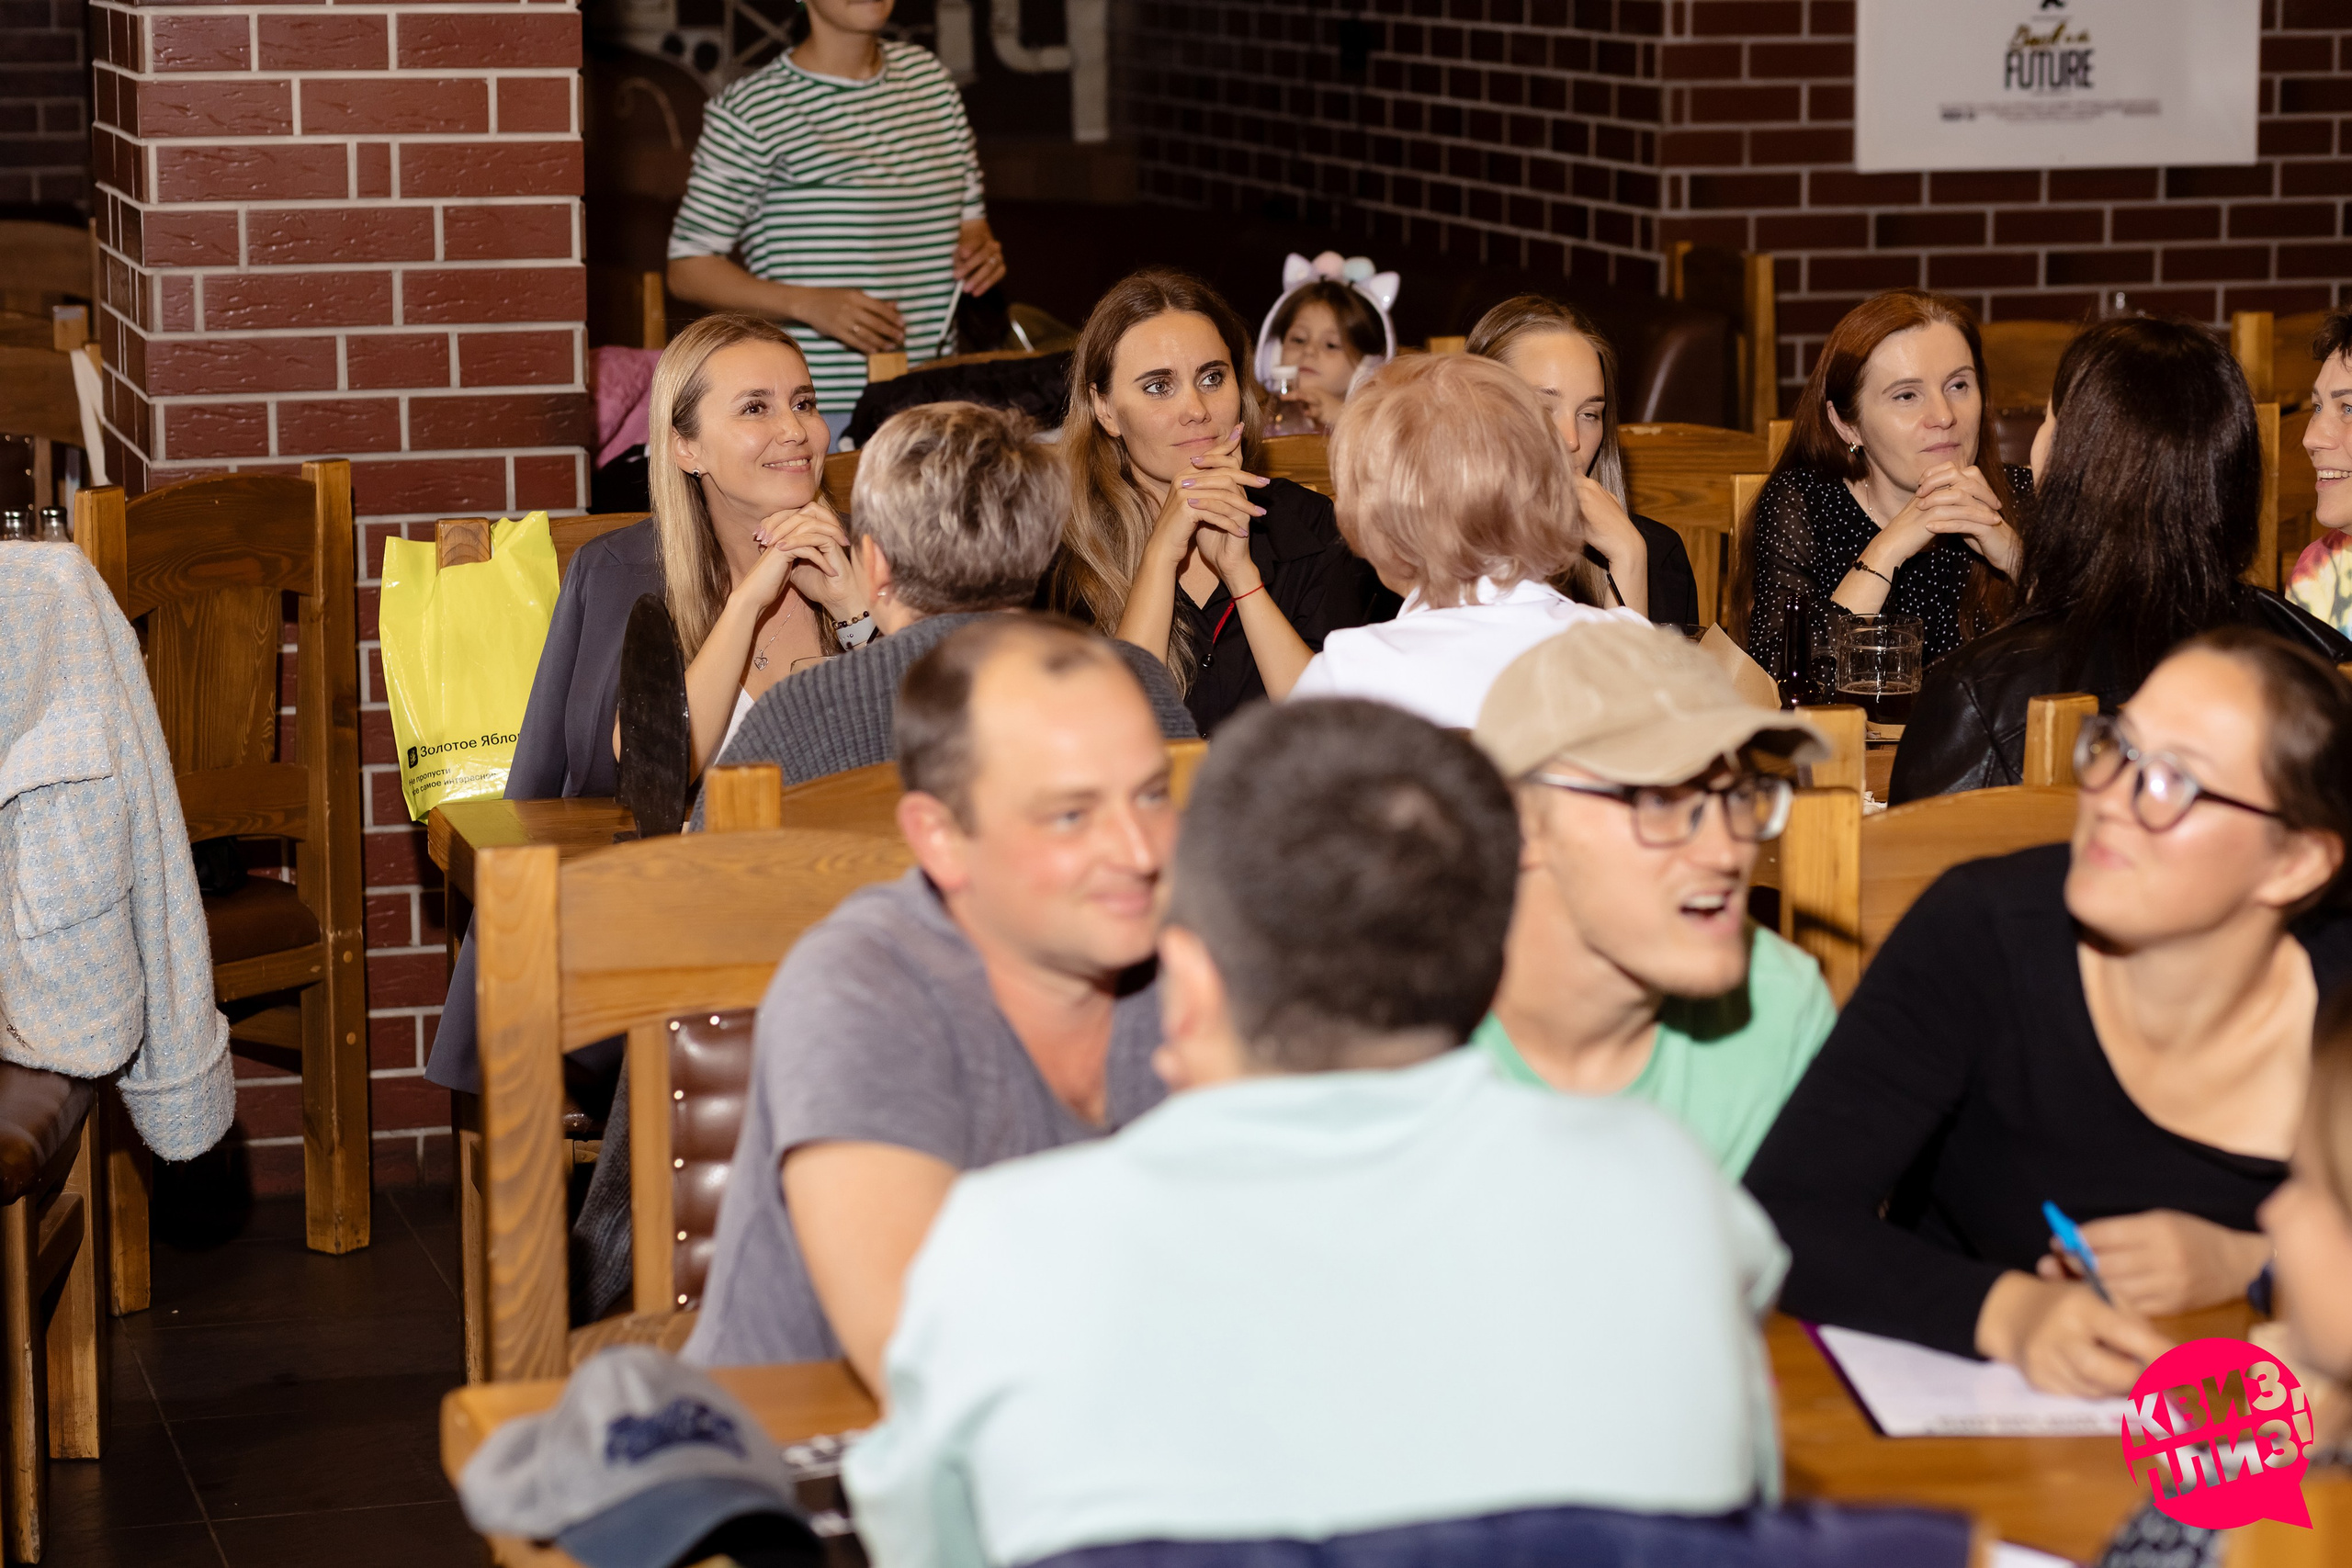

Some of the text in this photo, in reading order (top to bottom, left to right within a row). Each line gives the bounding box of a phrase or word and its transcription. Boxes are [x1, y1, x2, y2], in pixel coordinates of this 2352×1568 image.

[2005, 50, 2094, 89] FUTURE
[420, 732, 520, 758] Золотое Ябло
[408, 768, 451, 786] Не пропусти
[420, 780, 442, 793] самое
